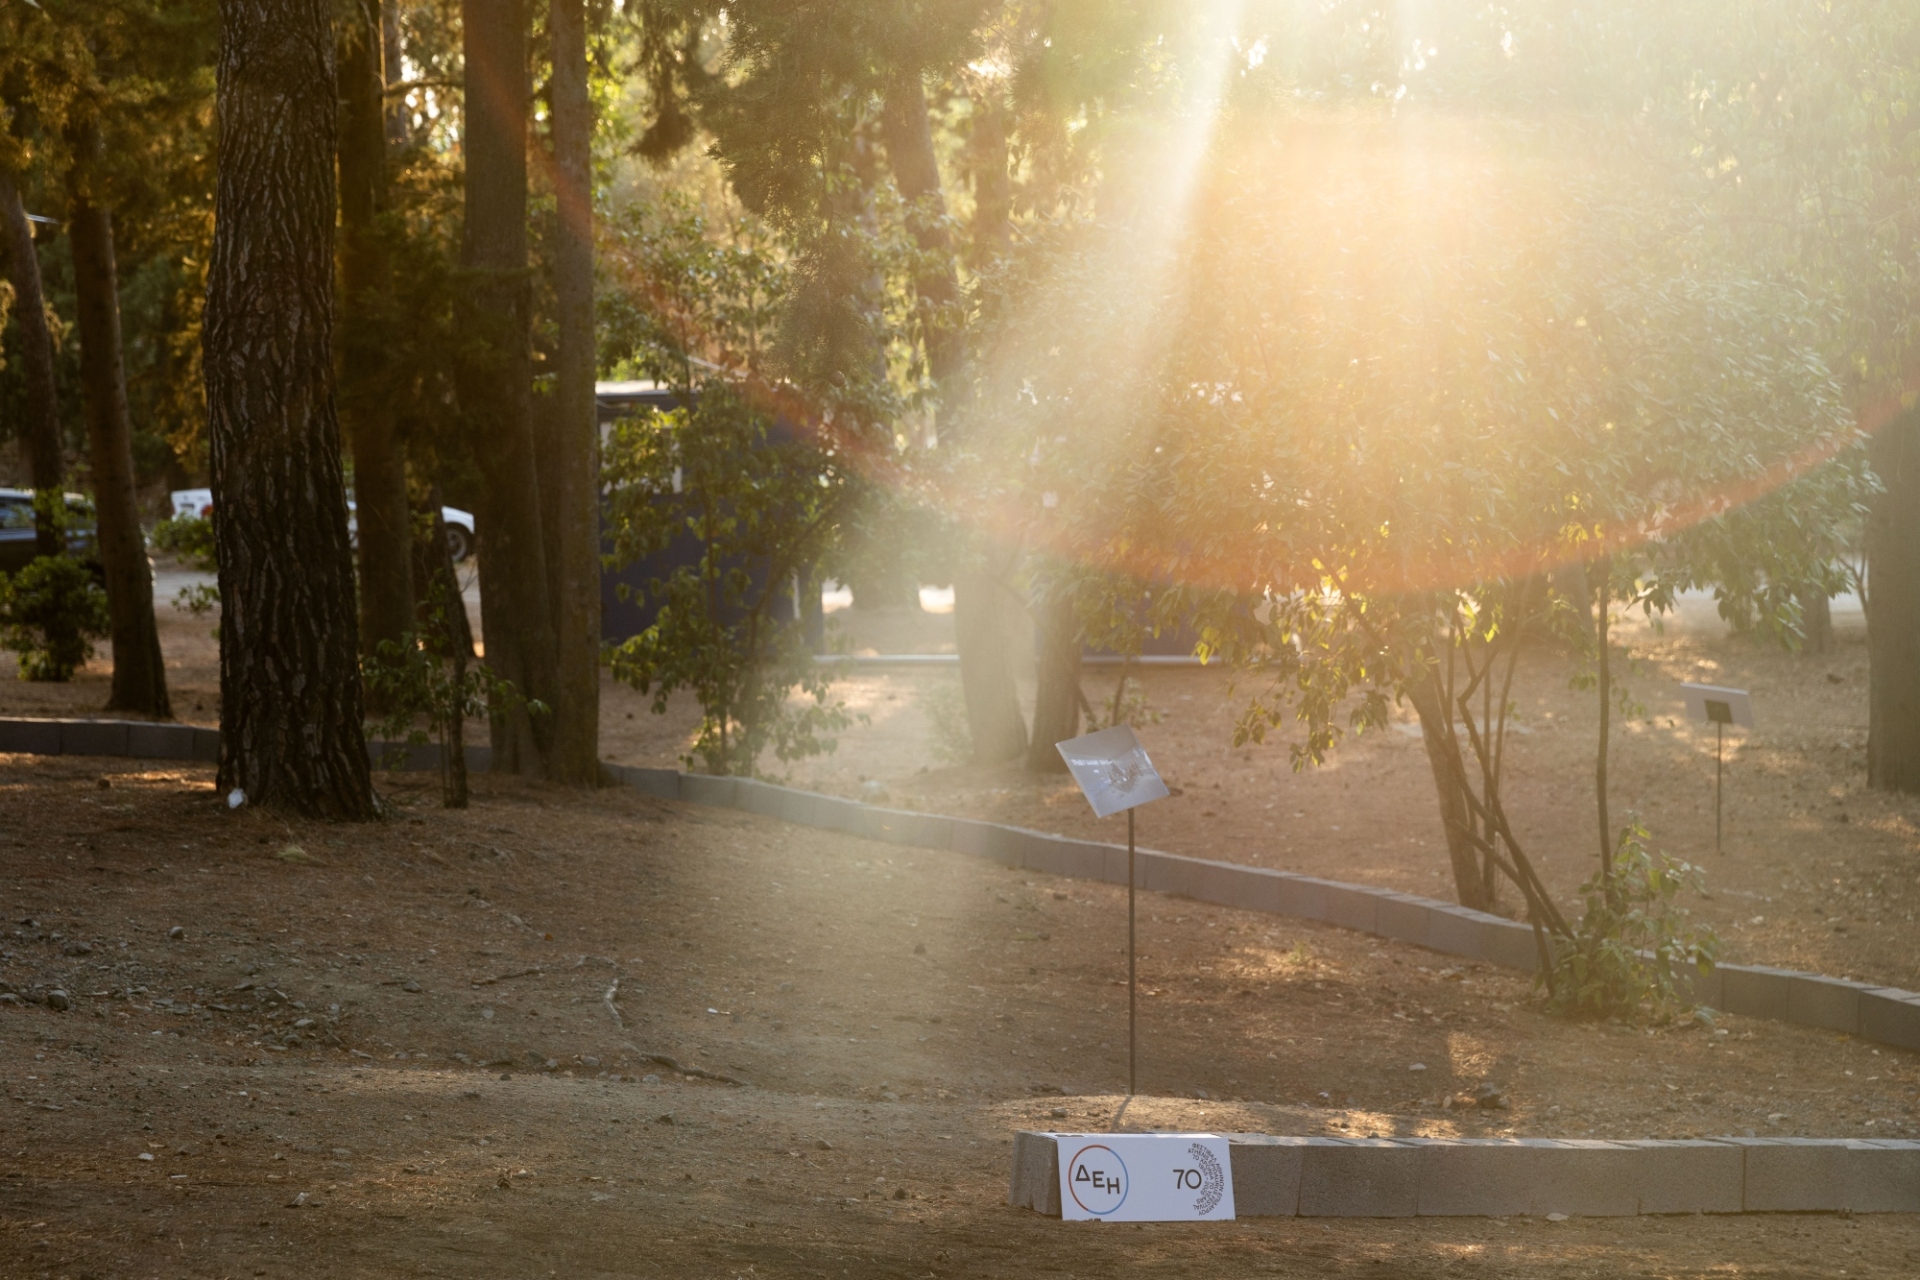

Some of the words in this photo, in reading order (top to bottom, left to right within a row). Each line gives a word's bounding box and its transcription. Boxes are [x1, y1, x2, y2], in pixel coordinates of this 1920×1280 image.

[1187, 1147, 1209, 1161] ATHENS
[1074, 1164, 1121, 1194] ΔΕΗ
[1173, 1169, 1202, 1190] 70
[1192, 1153, 1200, 1161] 70
[1196, 1190, 1212, 1205] YEARS
[1200, 1181, 1210, 1195] 2025
[1192, 1194, 1215, 1211] FESTIVAL
